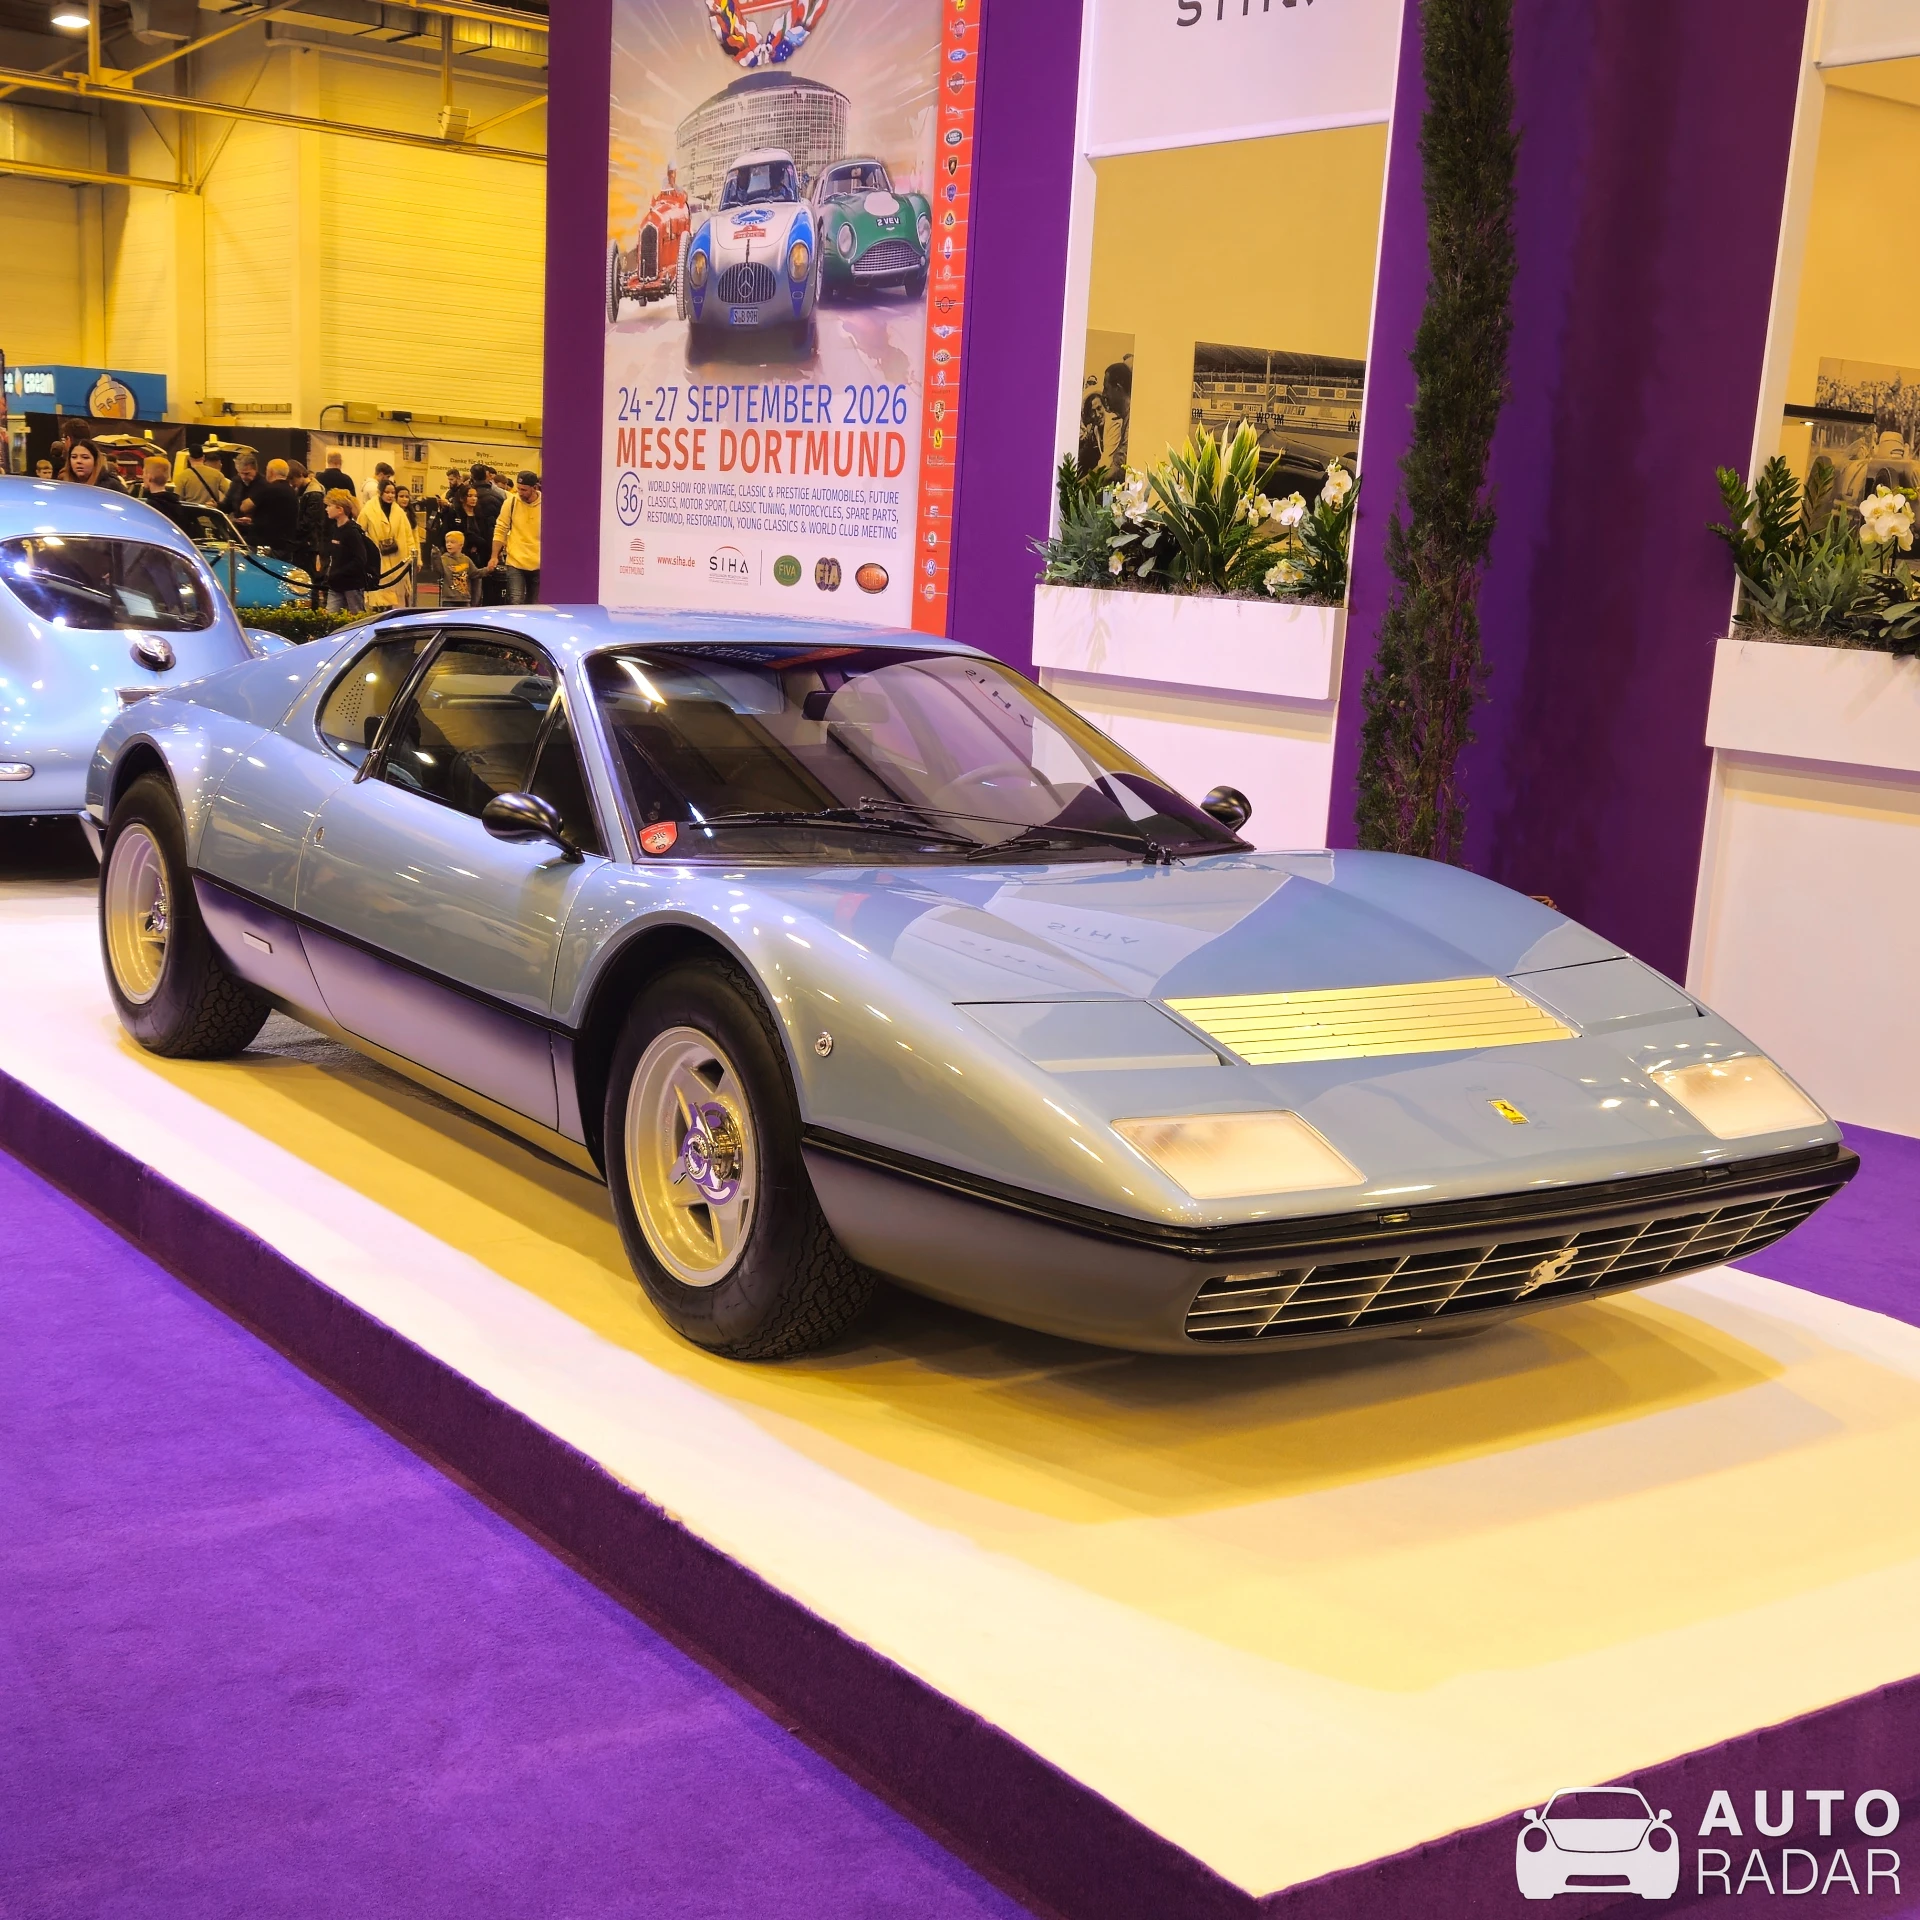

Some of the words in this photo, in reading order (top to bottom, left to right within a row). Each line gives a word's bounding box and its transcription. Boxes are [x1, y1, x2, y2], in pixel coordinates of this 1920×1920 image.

[686, 384, 832, 424] SEPTEMBER
[843, 383, 907, 425] 2026
[616, 426, 707, 471] MESSE
[718, 428, 906, 478] DORTMUND
[620, 483, 638, 513] 36
[647, 480, 671, 493] WORLD
[672, 481, 692, 494] SHOW
[693, 482, 706, 495] FOR
[707, 483, 737, 498] VINTAGE,
[738, 484, 766, 498] CLASSIC
[768, 485, 774, 498] &
[776, 486, 810, 501] PRESTIGE
[811, 488, 867, 505] AUTOMOBILES,
[869, 490, 900, 505] FUTURE
[647, 495, 678, 511] CLASSICS,
[679, 497, 703, 511] MOTOR
[704, 499, 728, 514] SPORT,
[729, 500, 757, 514] CLASSIC
[759, 502, 787, 518] TUNING,
[788, 503, 844, 520] MOTORCYCLES,
[845, 506, 870, 521] SPARE
[872, 508, 899, 525] PARTS,
[646, 511, 685, 526] RESTOMOD,
[686, 514, 735, 530] RESTORATION,
[736, 516, 762, 531] YOUNG
[763, 518, 798, 533] CLASSICS
[800, 520, 807, 533] &
[808, 522, 837, 536] WORLD
[839, 523, 860, 537] CLUB
[861, 525, 897, 540] MEETING
[629, 556, 645, 566] MESSE
[656, 556, 696, 568] www.siha.de
[709, 556, 749, 574] SIHA
[779, 564, 796, 577] FIVA
[815, 562, 841, 585] FIA
